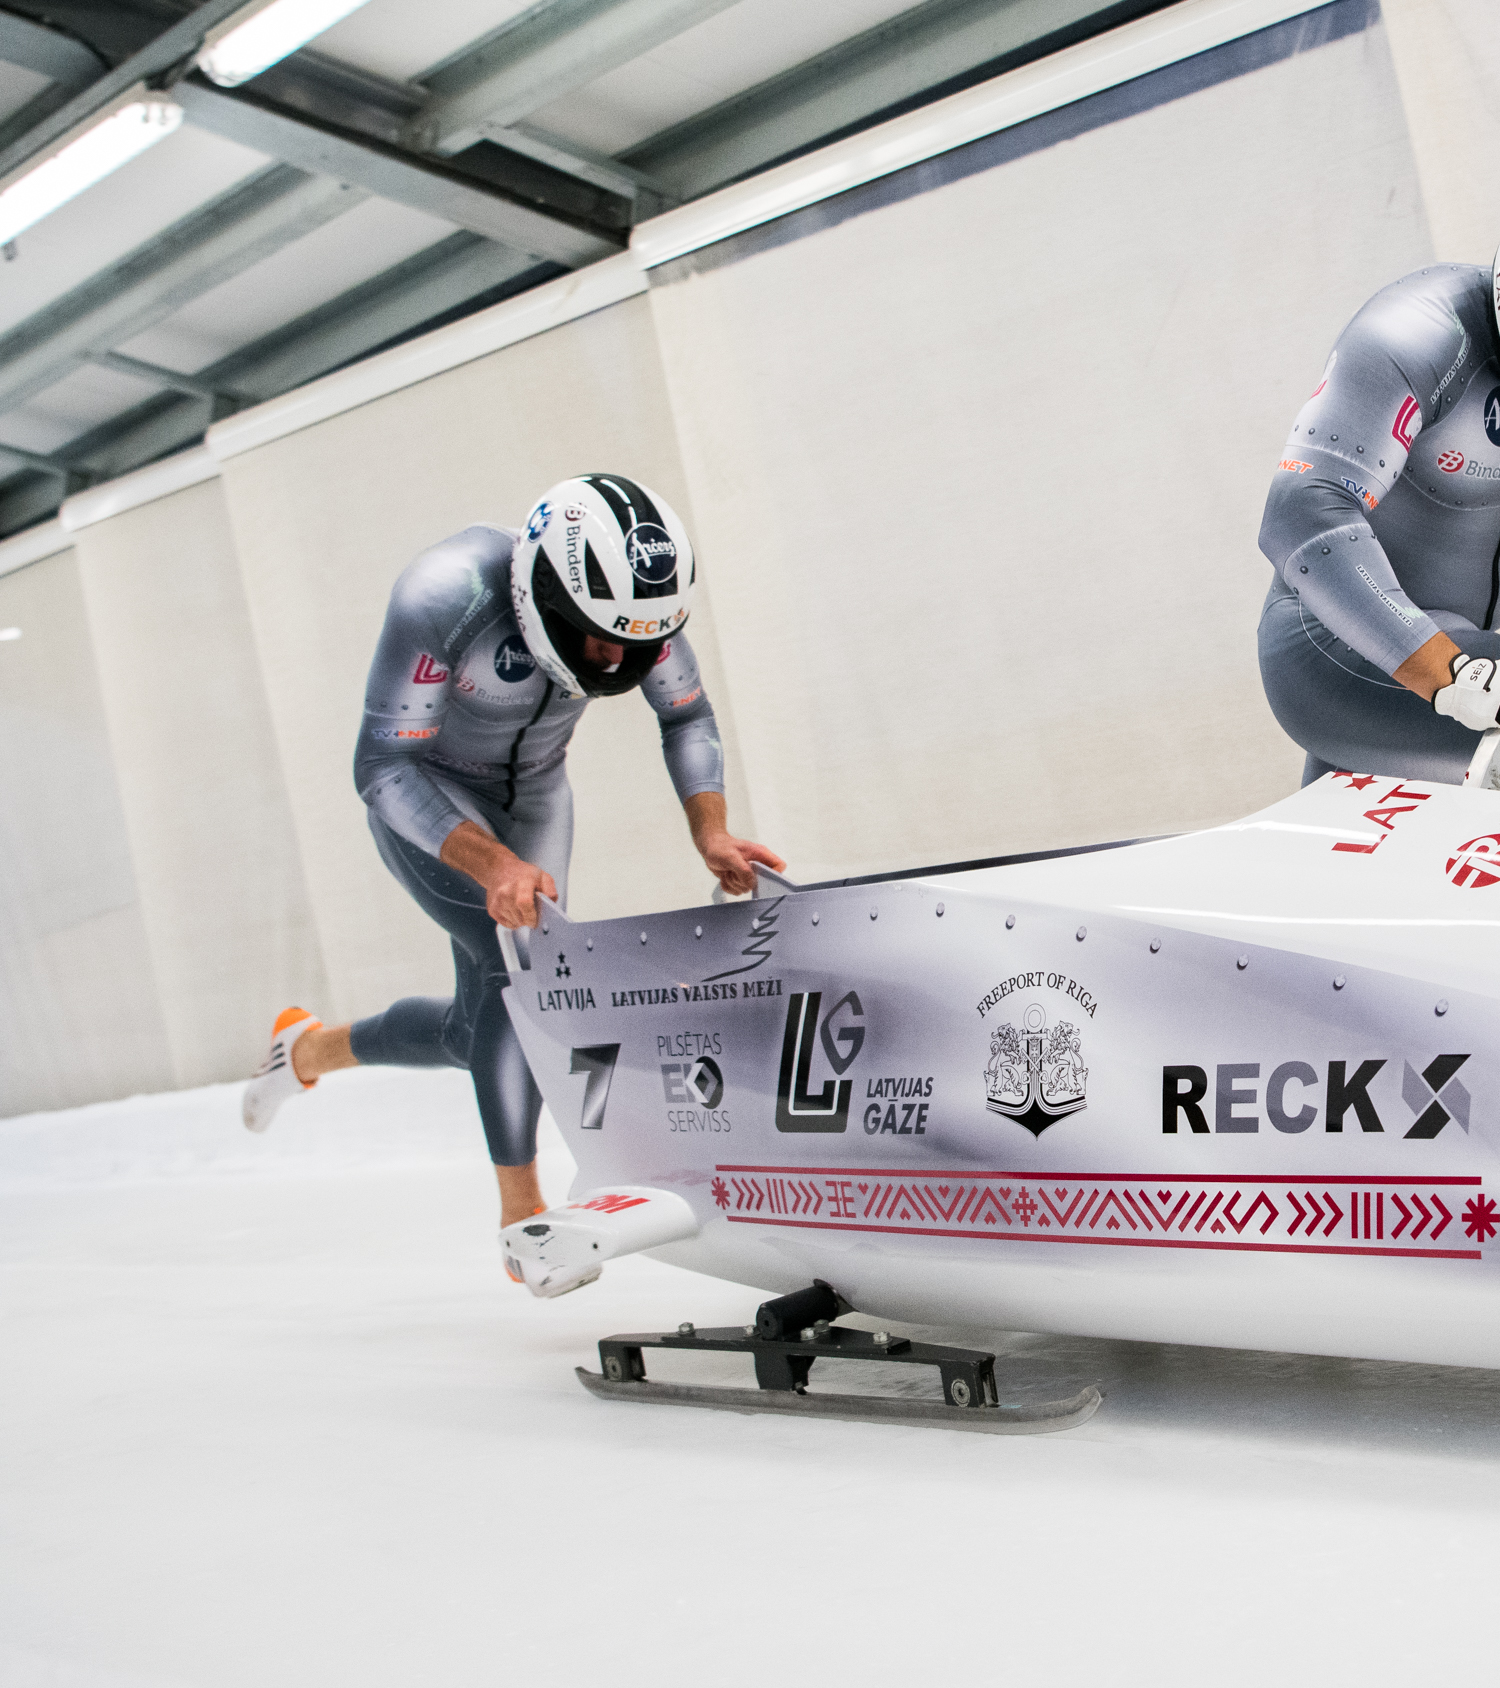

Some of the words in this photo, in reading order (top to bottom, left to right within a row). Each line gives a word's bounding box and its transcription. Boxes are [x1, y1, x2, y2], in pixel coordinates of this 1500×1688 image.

[567, 525, 584, 594] Binders
[537, 987, 597, 1012] LATVIJA
[611, 987, 679, 1008] LATVIJAS
[684, 982, 738, 1003] VALSTS
[742, 976, 784, 998] MEŽI
[976, 971, 1045, 1019] FREEPORT
[1046, 972, 1067, 990] OF
[1067, 980, 1099, 1019] RIGA
[657, 1031, 722, 1057] PILSĒTAS
[569, 1042, 622, 1130] 7
[866, 1076, 934, 1099] LATVIJAS
[667, 1109, 732, 1133] SERVISS
[862, 1099, 930, 1136] GĀZE
